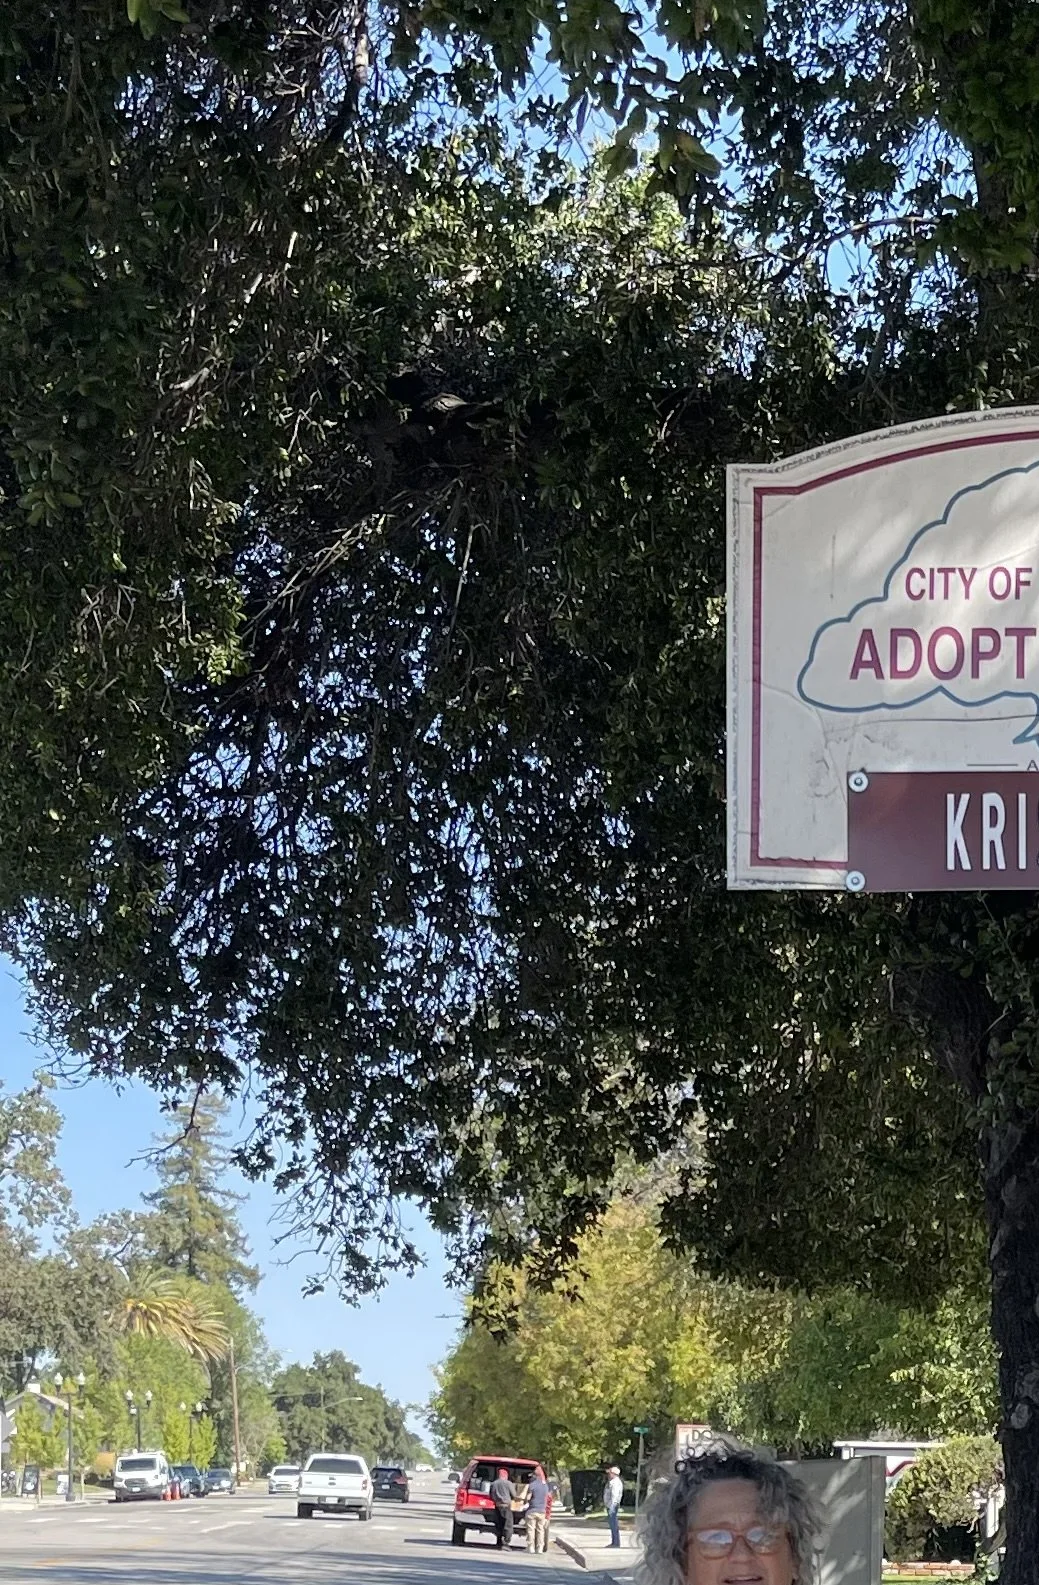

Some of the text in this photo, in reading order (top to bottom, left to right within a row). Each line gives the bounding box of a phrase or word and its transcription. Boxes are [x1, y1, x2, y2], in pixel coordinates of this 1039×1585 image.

[905, 567, 976, 601] CITY
[989, 567, 1031, 601] OF
[849, 626, 1037, 681] ADOPT
